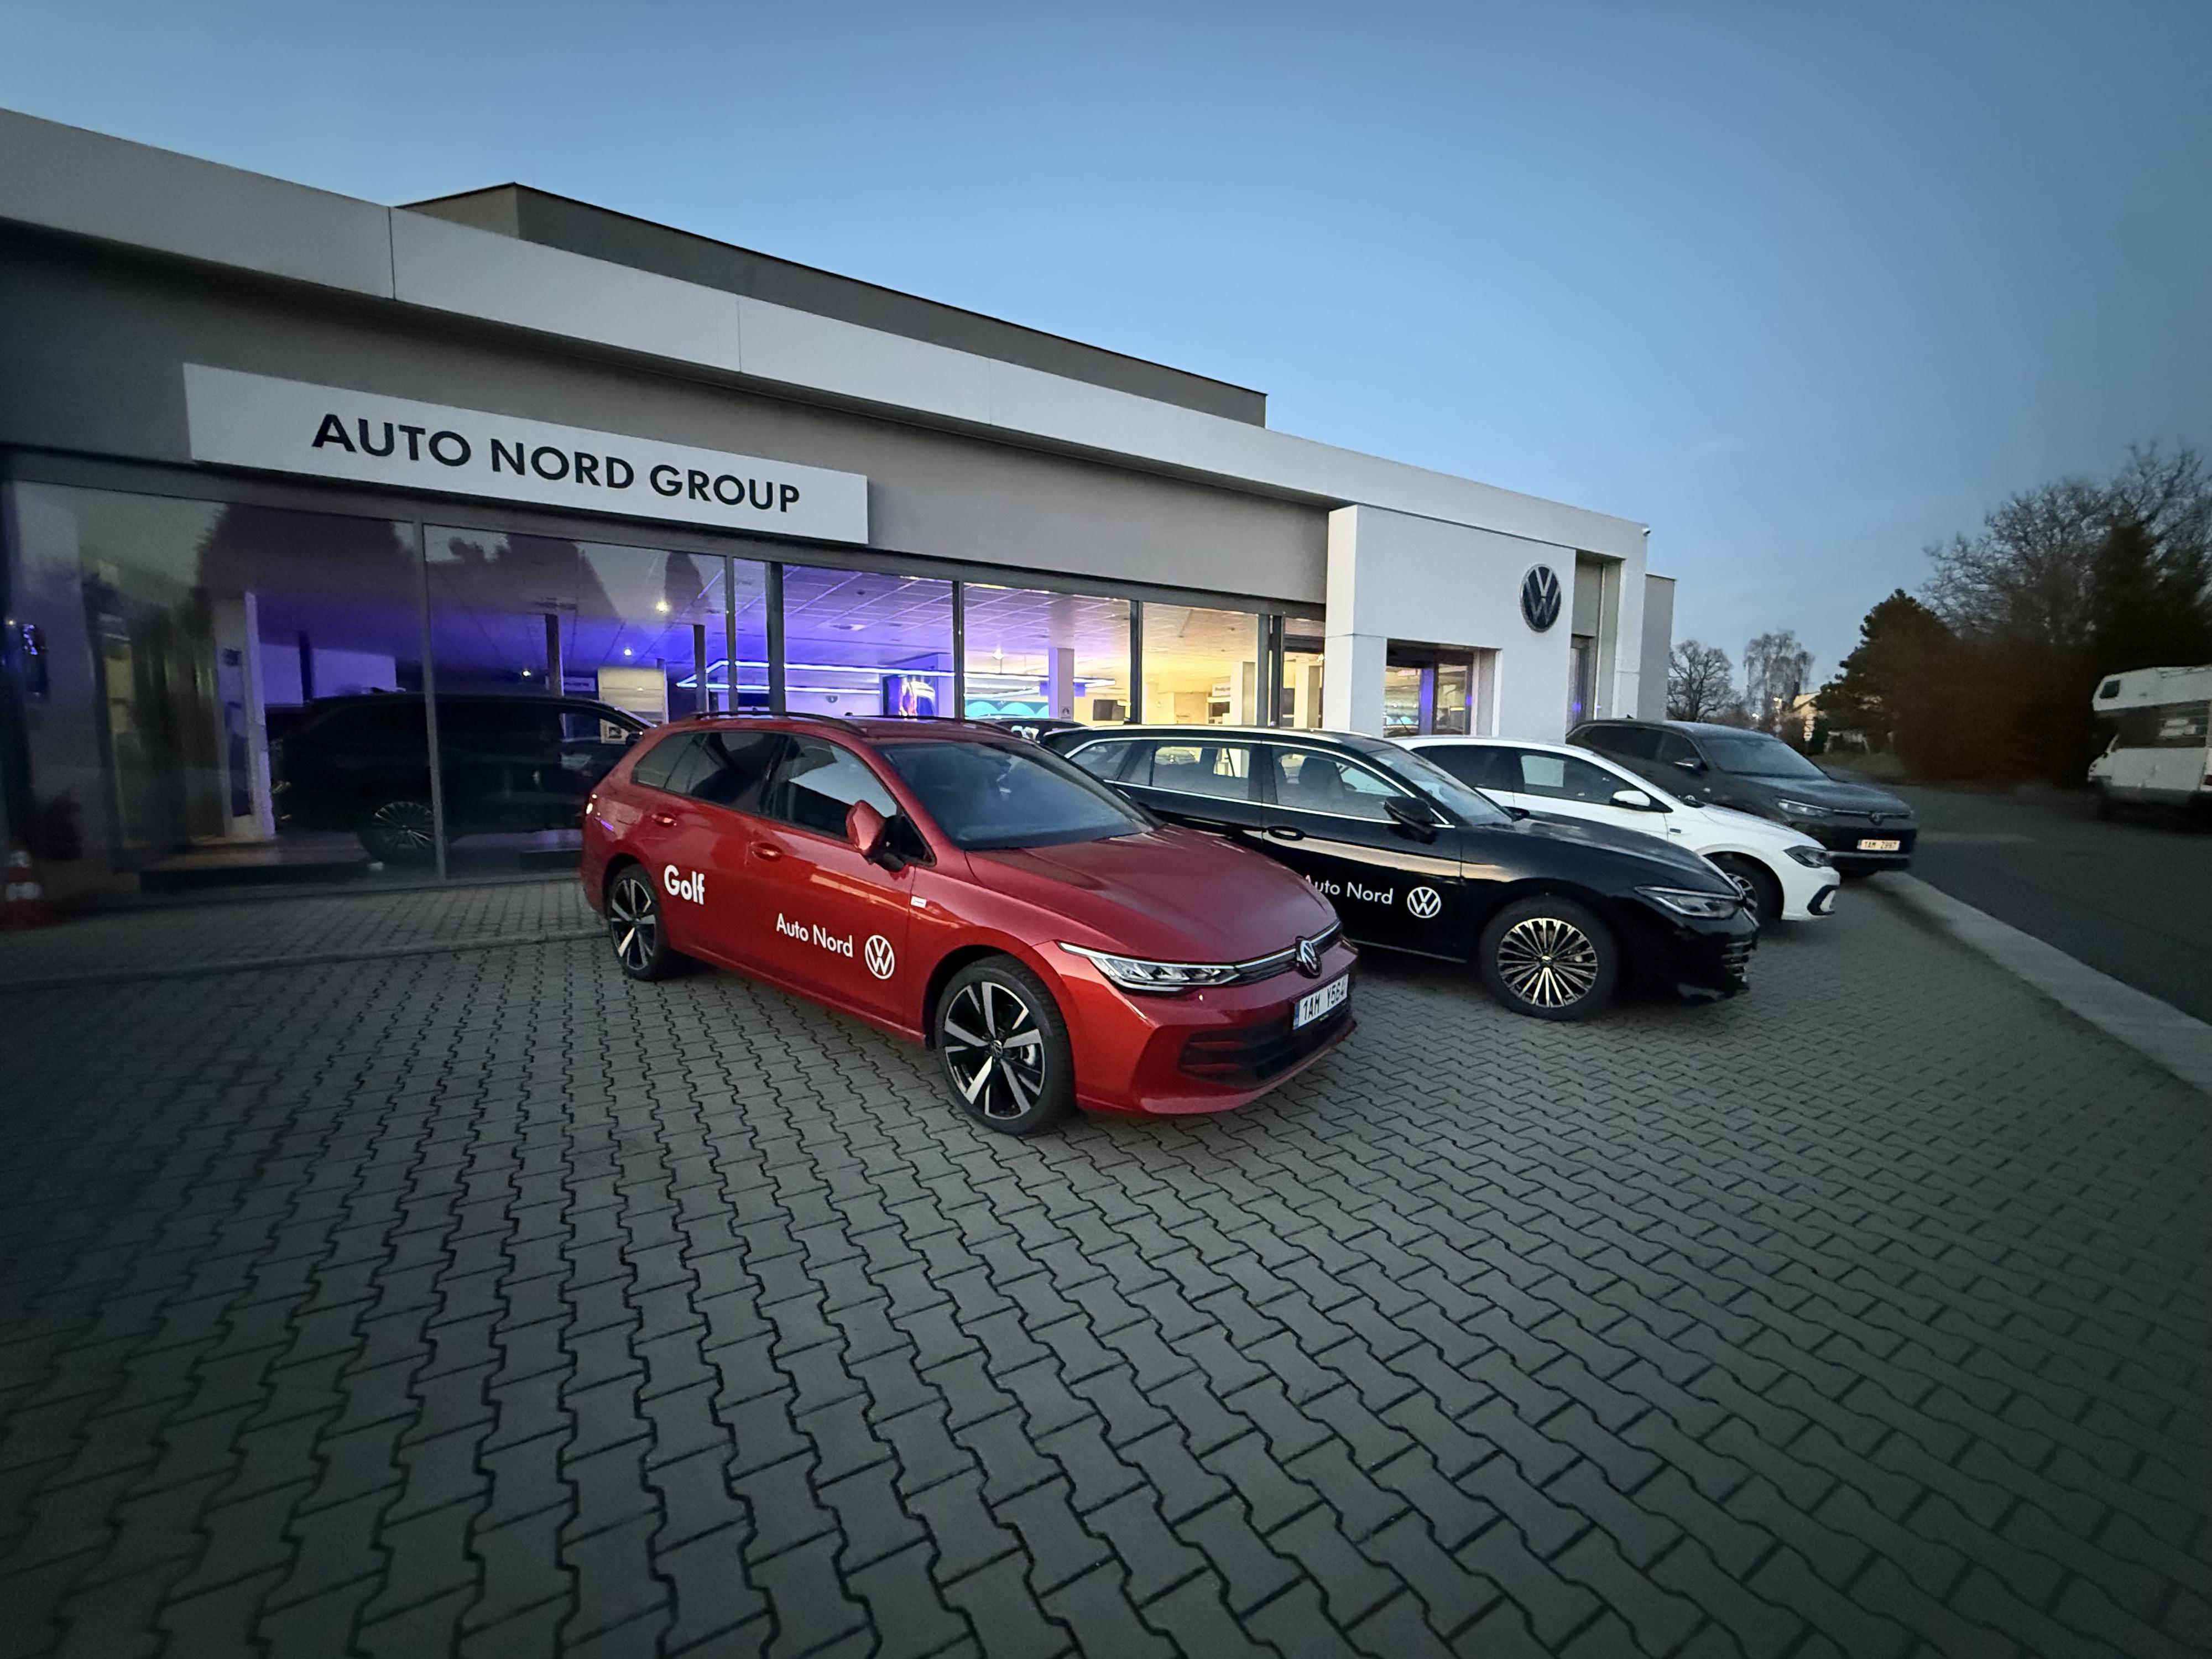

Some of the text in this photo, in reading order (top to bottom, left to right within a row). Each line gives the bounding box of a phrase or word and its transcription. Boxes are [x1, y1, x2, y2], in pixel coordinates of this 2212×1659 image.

[311, 414, 800, 513] AUTO NORD GROUP
[664, 864, 705, 905] Golf
[1347, 881, 1394, 905] Nord
[1407, 886, 1441, 919] VW
[776, 913, 854, 958] Auto Nord
[864, 935, 895, 979] VW
